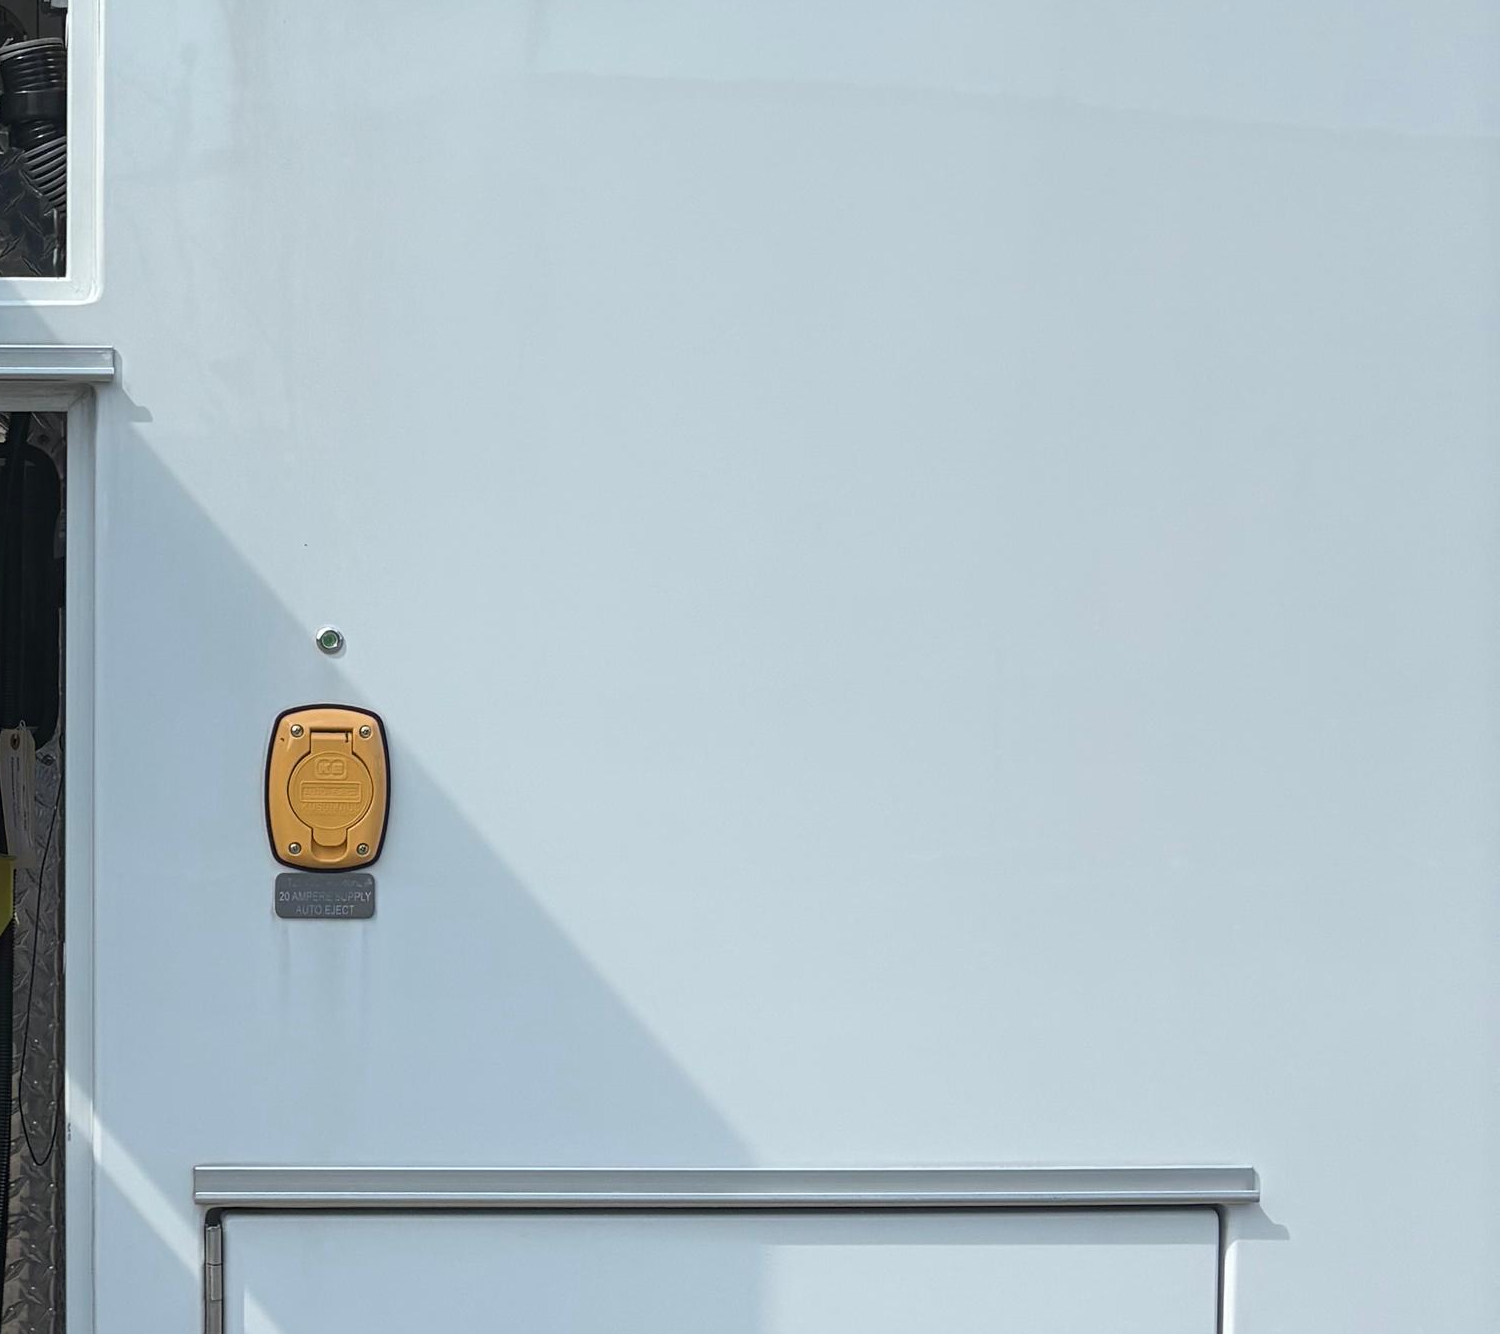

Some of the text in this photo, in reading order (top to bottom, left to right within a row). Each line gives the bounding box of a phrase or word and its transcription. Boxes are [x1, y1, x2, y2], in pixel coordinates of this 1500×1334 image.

[279, 892, 371, 901] 20 AMPERE SUPPLY
[296, 905, 354, 915] AUTO EJECT
